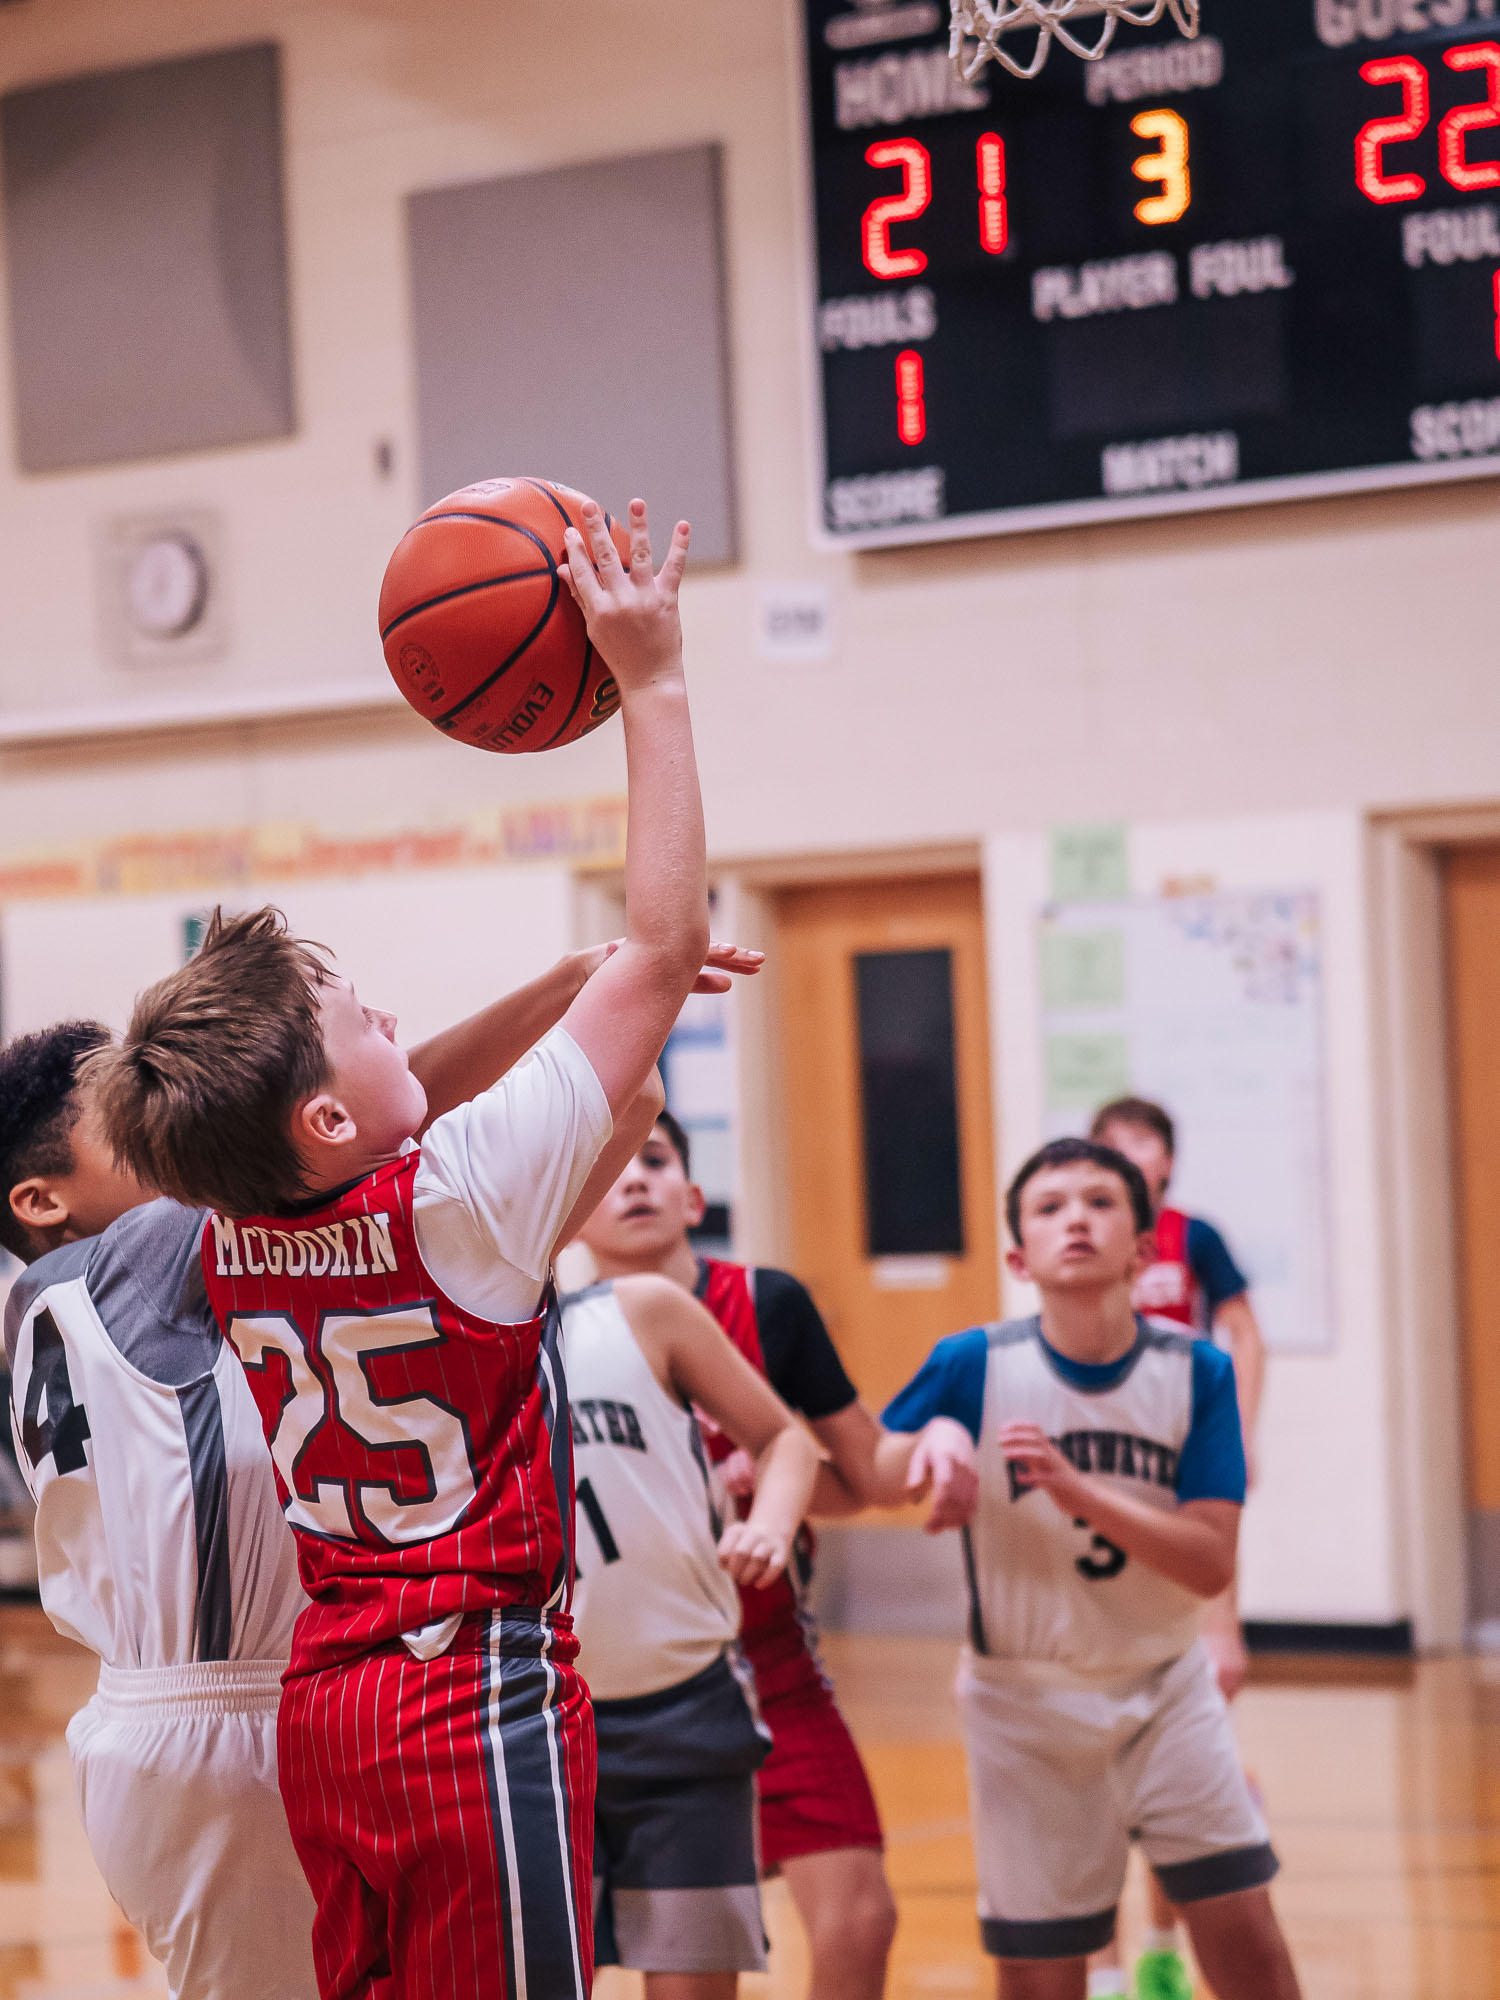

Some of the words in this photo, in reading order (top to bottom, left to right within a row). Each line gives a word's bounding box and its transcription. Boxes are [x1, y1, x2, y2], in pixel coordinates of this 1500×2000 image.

[1086, 38, 1223, 105] PERIOD
[1314, 0, 1496, 48] GUE
[1130, 108, 1191, 225] 3
[1353, 41, 1500, 205] 22
[861, 132, 1008, 280] 21
[822, 287, 936, 350] FOULS
[1032, 251, 1177, 321] PLAYER
[1190, 237, 1293, 297] FOUL
[895, 350, 926, 446] 1
[1102, 432, 1240, 496] MATCH
[22, 1305, 92, 1476] 4
[227, 1299, 483, 1543] 25
